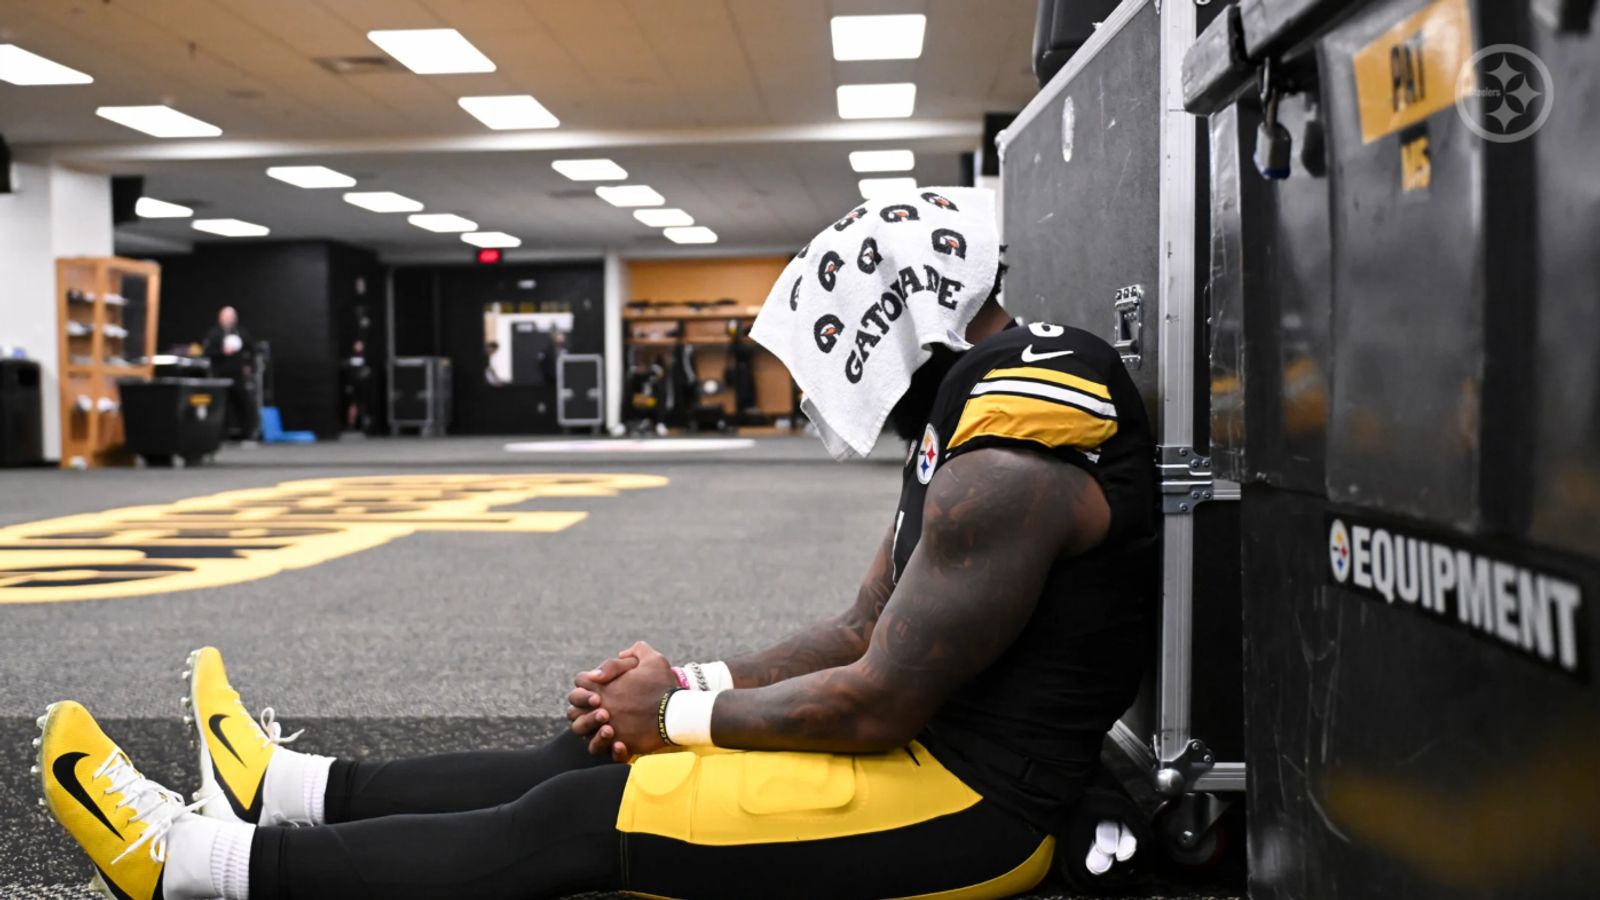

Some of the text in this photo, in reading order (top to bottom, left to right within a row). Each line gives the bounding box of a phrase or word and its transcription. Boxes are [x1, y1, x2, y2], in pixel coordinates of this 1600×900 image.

[879, 204, 920, 223] G
[931, 228, 967, 260] G
[818, 251, 845, 292] G
[813, 314, 845, 354] G
[1351, 525, 1581, 671] EQUIPMENT
